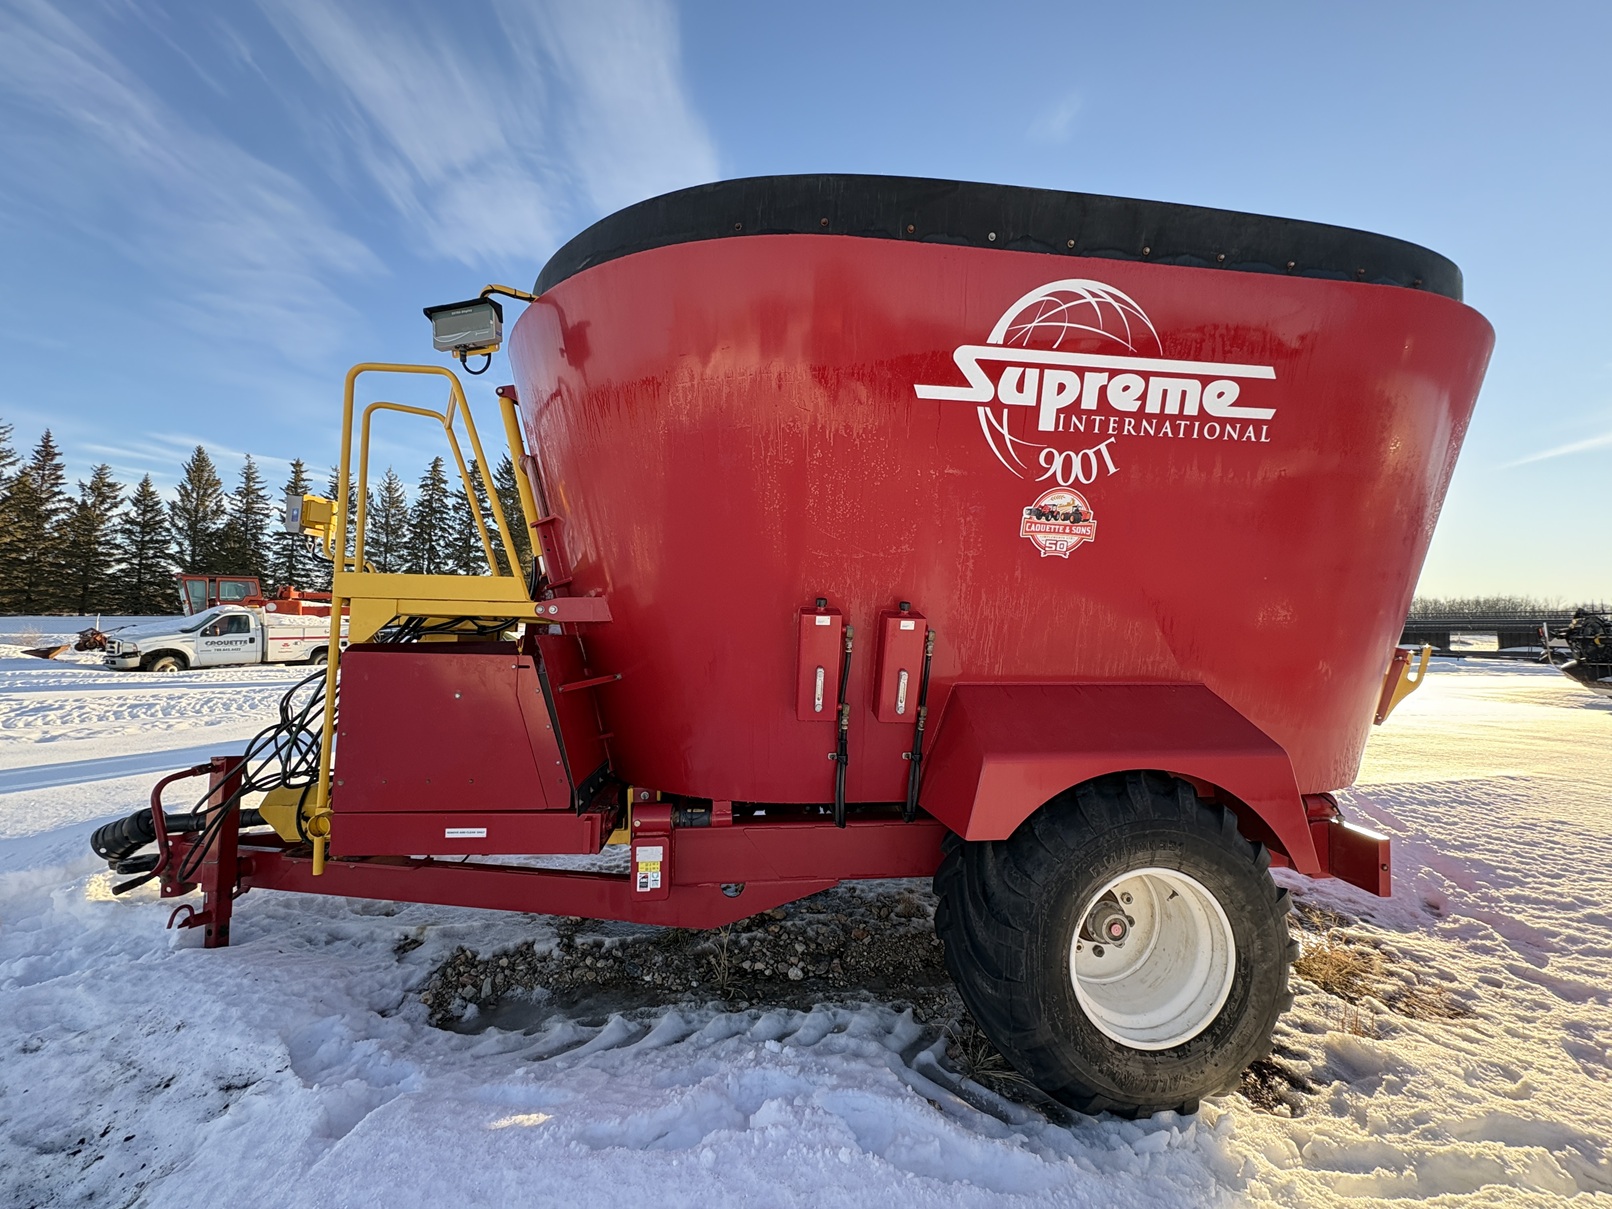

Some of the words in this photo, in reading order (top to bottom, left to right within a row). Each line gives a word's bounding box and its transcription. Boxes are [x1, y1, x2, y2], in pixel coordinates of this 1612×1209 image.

[914, 345, 1277, 432] Supreme
[1057, 413, 1271, 443] INTERNATIONAL
[1035, 437, 1120, 486] 900T
[1026, 523, 1064, 532] CAOUETTE
[1071, 526, 1092, 535] SONS
